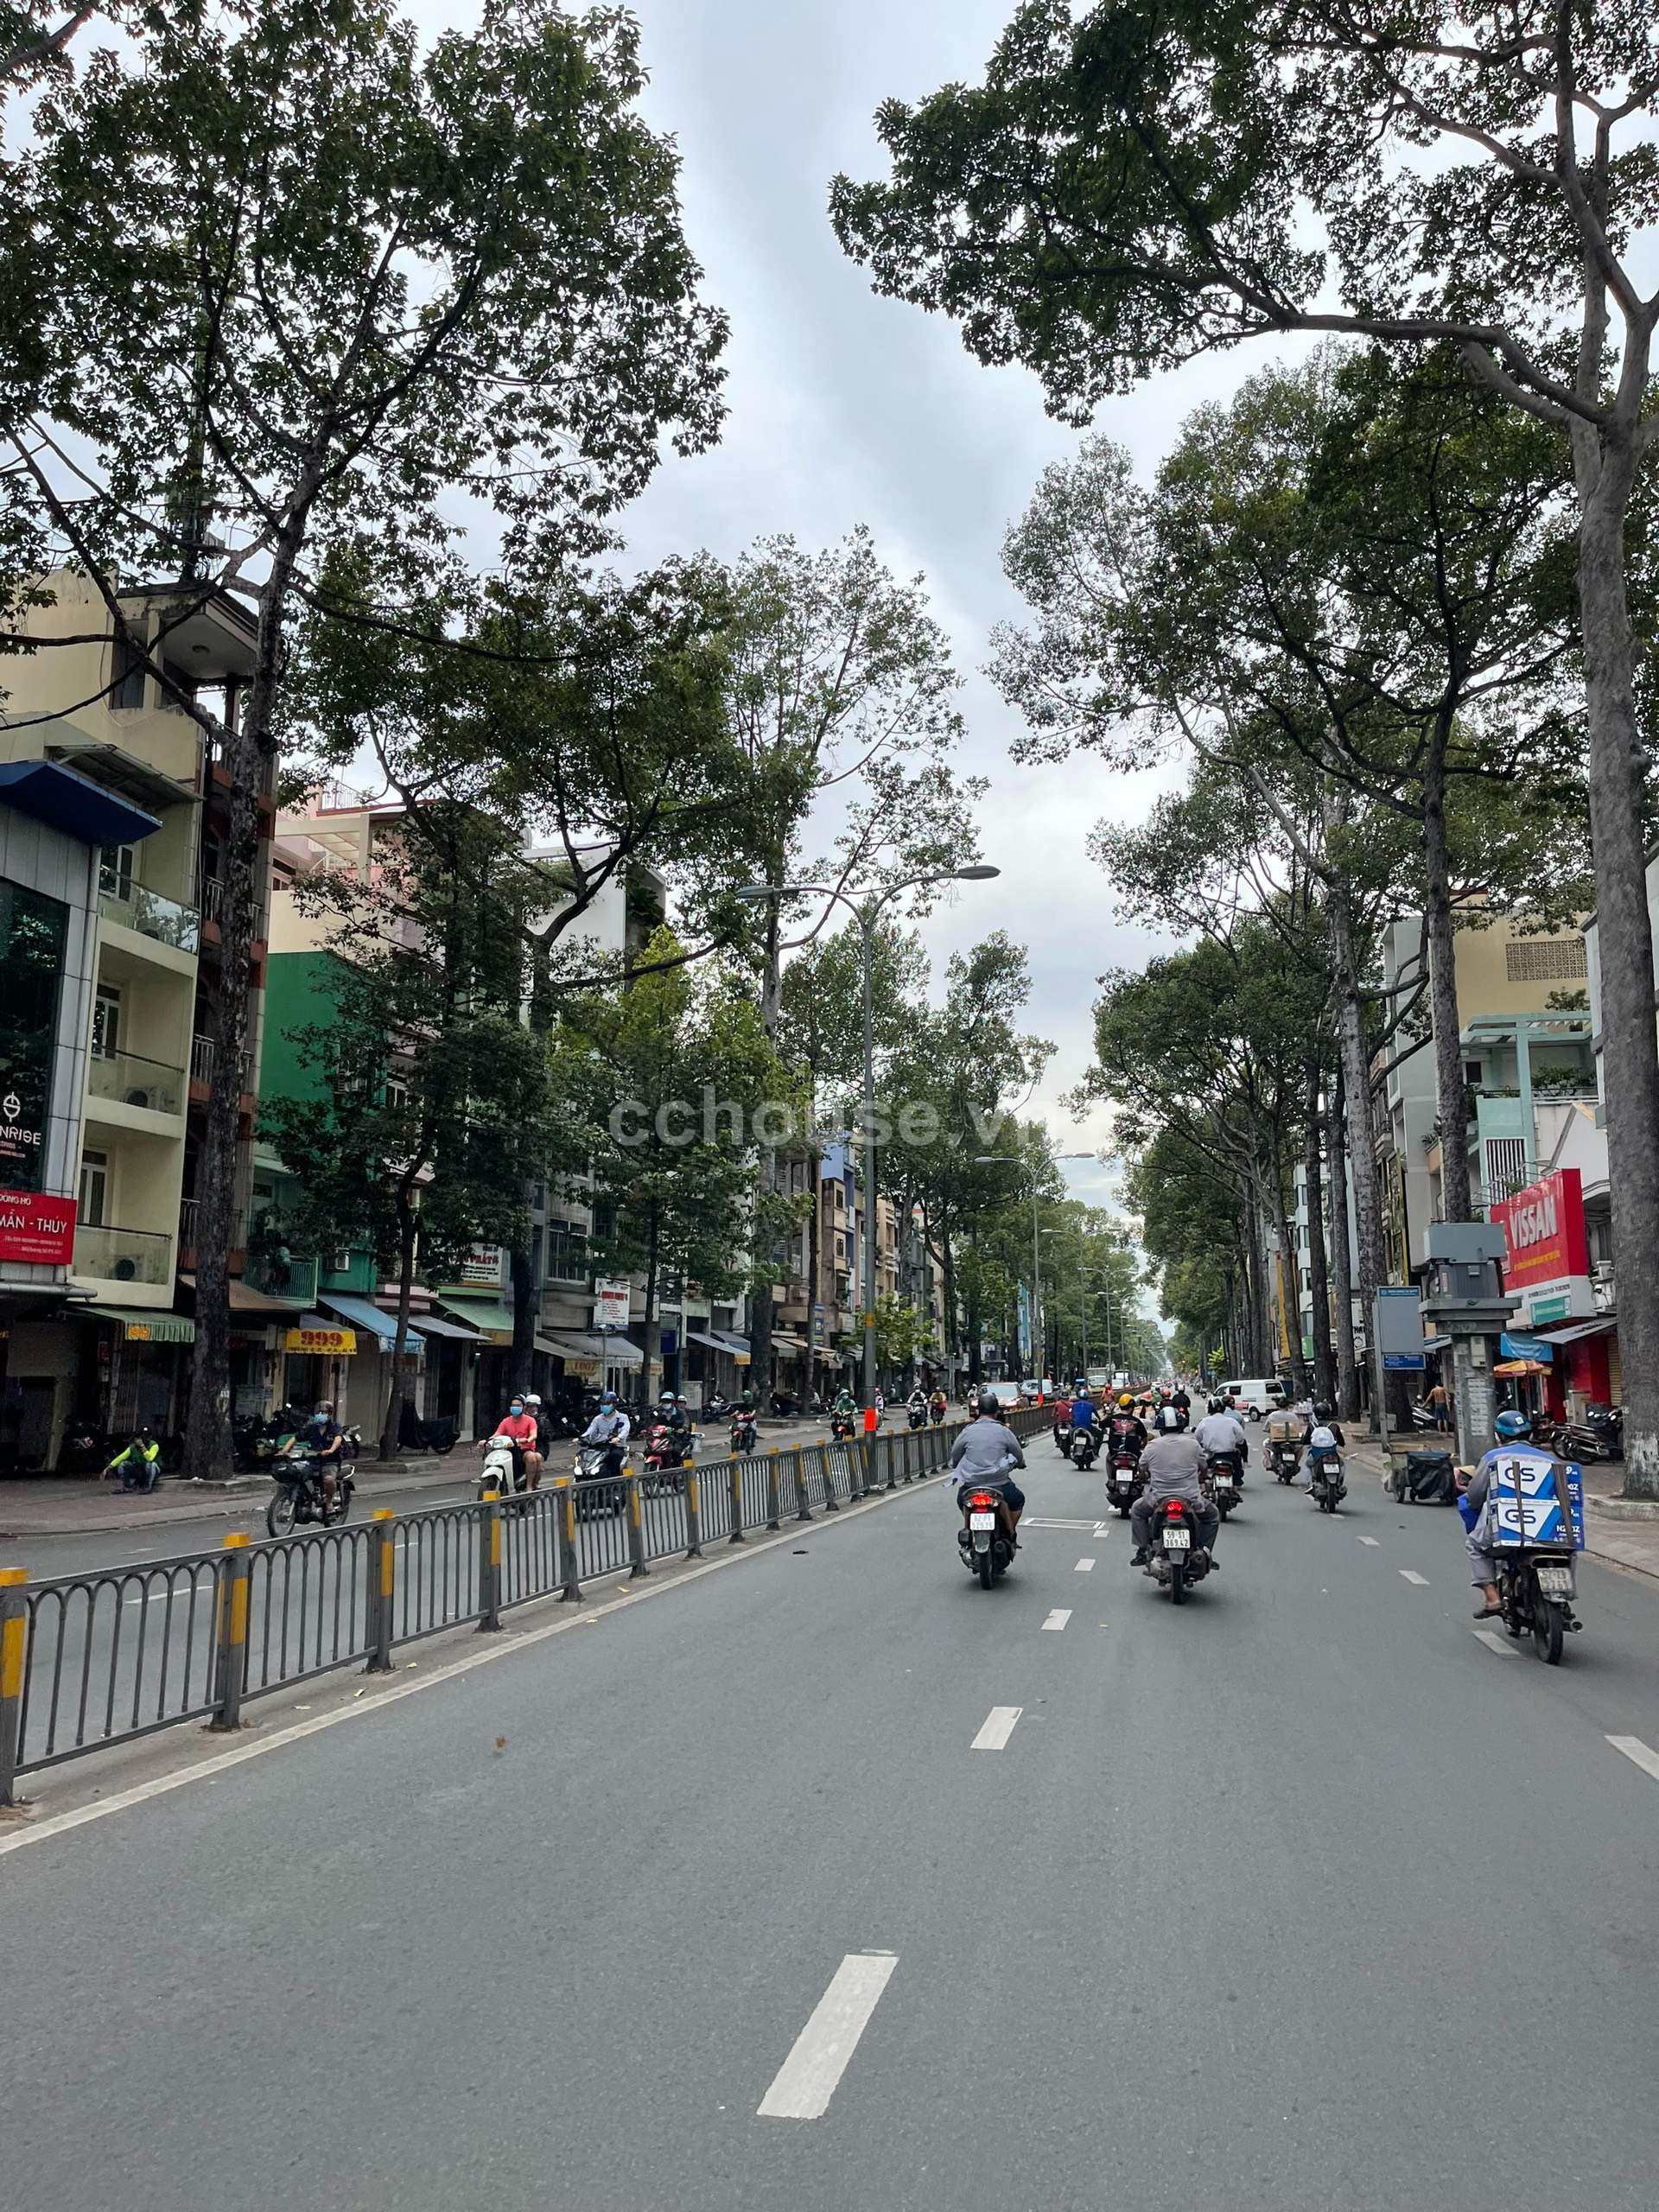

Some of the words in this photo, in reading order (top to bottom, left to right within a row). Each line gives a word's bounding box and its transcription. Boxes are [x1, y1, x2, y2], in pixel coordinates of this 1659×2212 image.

[1510, 1195, 1558, 1249] VISSAN
[302, 1332, 342, 1345] 999
[1504, 1509, 1536, 1524] GS
